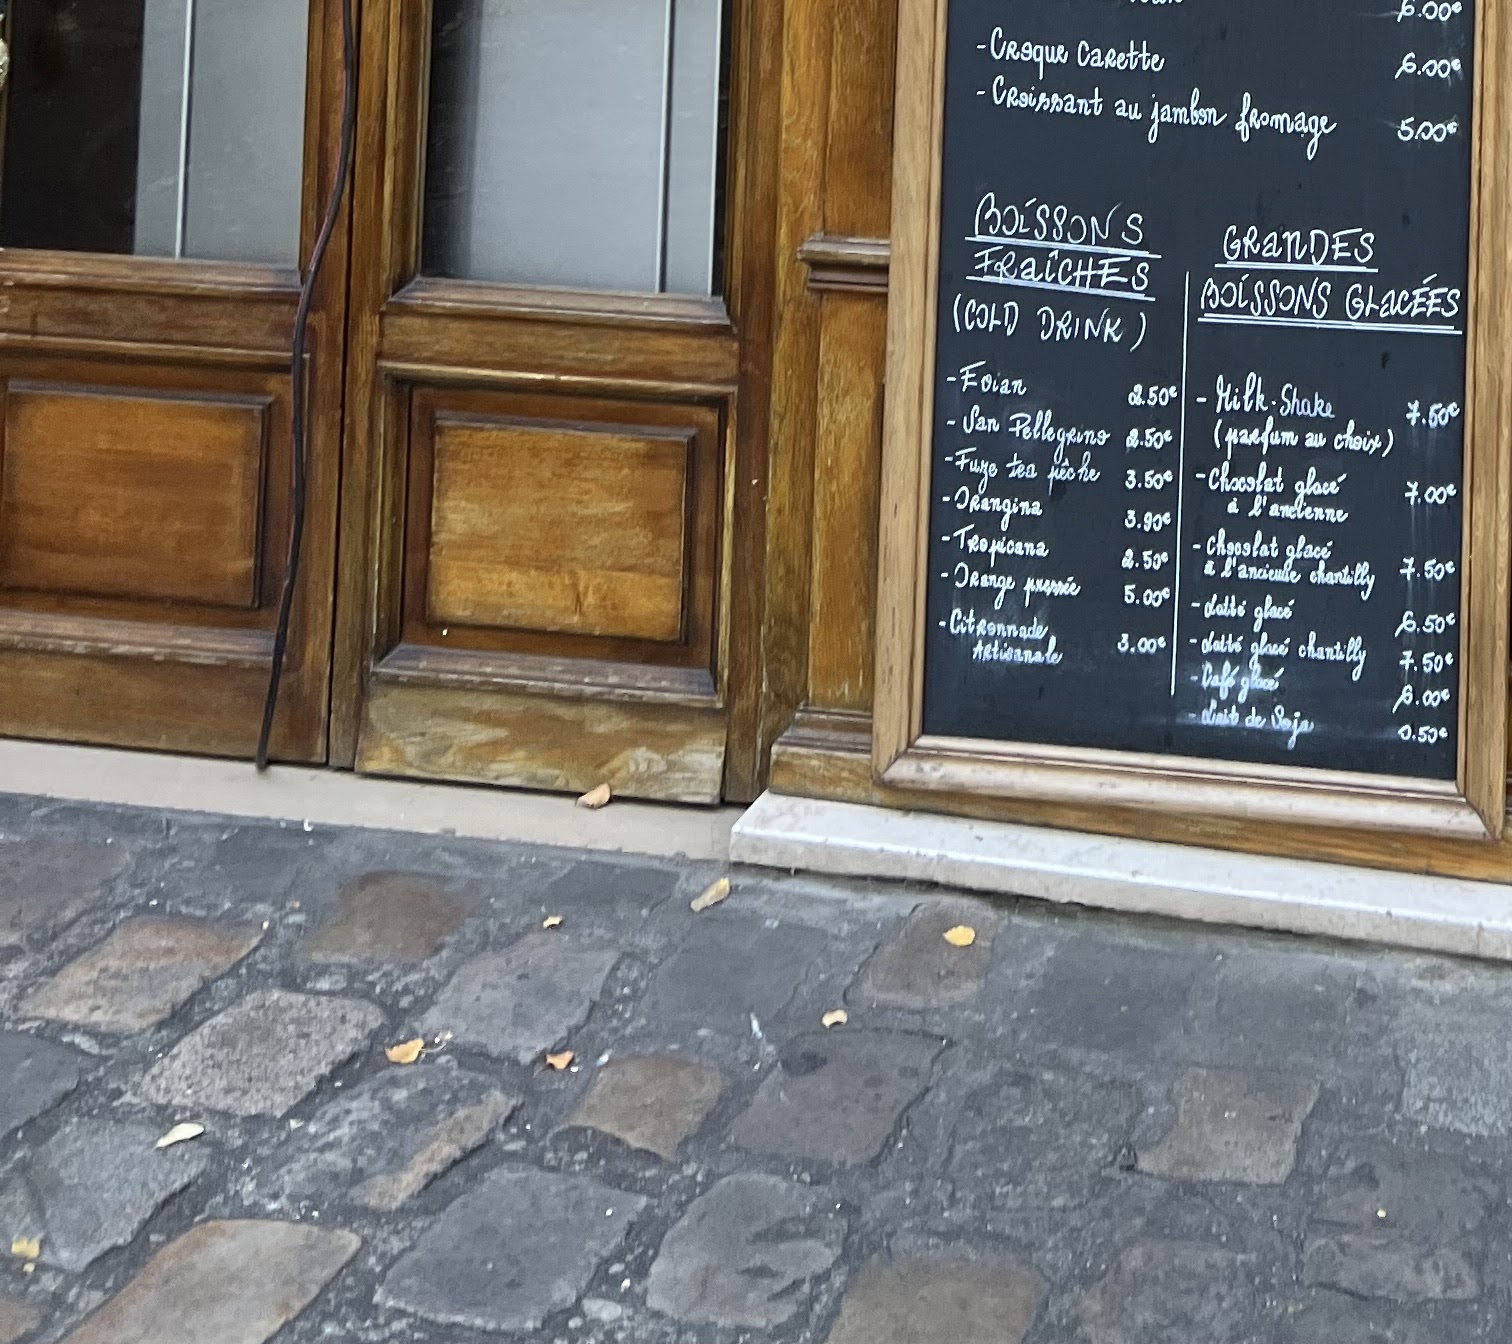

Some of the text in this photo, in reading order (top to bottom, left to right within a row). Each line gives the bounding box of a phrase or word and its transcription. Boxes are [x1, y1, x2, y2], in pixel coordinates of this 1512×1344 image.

[1077, 40, 1165, 72] Carette
[1114, 98, 1143, 121] au
[1147, 87, 1228, 144] jambon
[1235, 92, 1338, 161] fromage
[975, 192, 1145, 246] BOISSONS
[1222, 225, 1376, 264] GRANDES
[953, 293, 1019, 335] (COLD
[1200, 272, 1461, 319] BOISSONS GLACÉES
[1008, 409, 1111, 458] Pellegrino
[1304, 431, 1327, 448] au
[1005, 453, 1038, 479] tea
[1047, 451, 1101, 496] pêche
[1308, 560, 1376, 601] chantilly
[1297, 630, 1368, 683] chantilly
